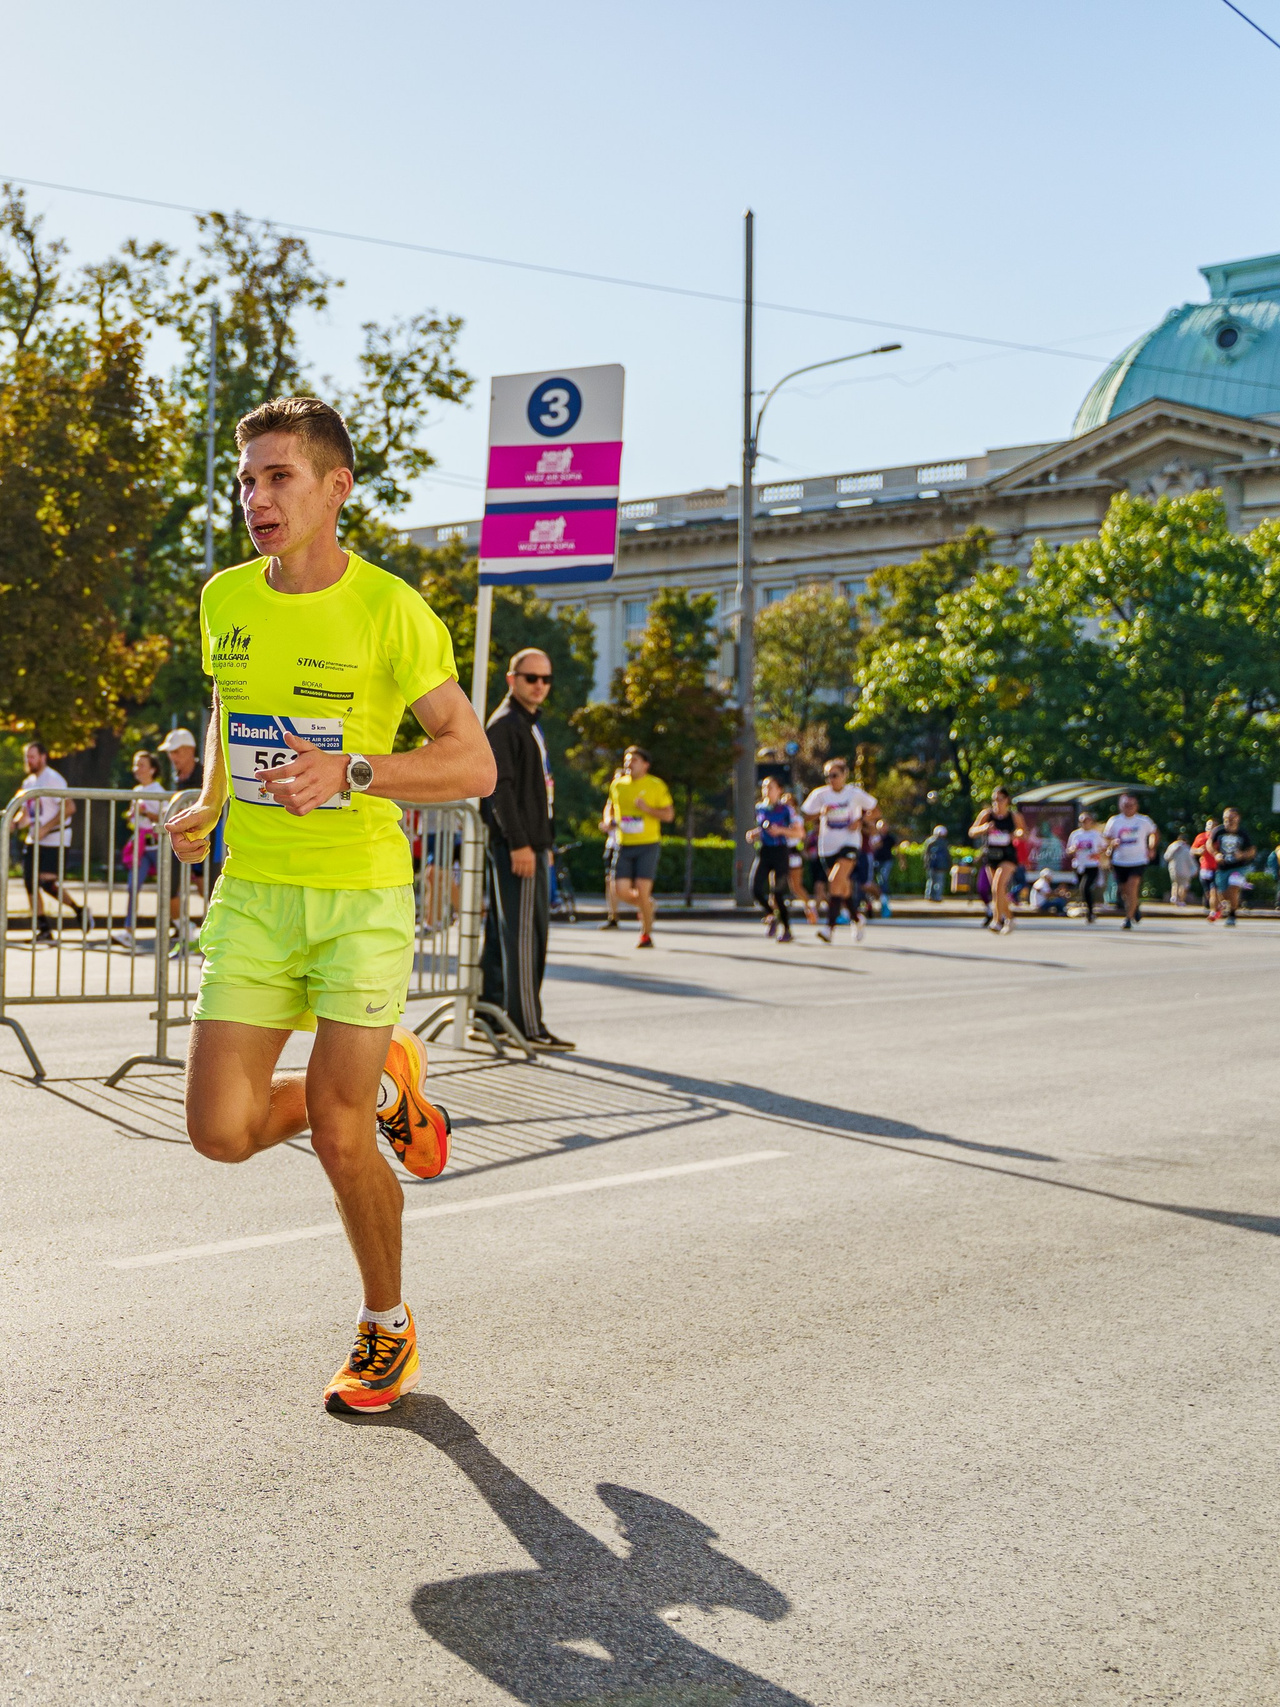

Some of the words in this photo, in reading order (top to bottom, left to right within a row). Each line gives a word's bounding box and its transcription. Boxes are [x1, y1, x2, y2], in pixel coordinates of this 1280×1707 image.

[539, 388, 570, 428] 3
[296, 657, 325, 669] STING
[230, 722, 279, 740] Fibank
[253, 750, 298, 772] 56
